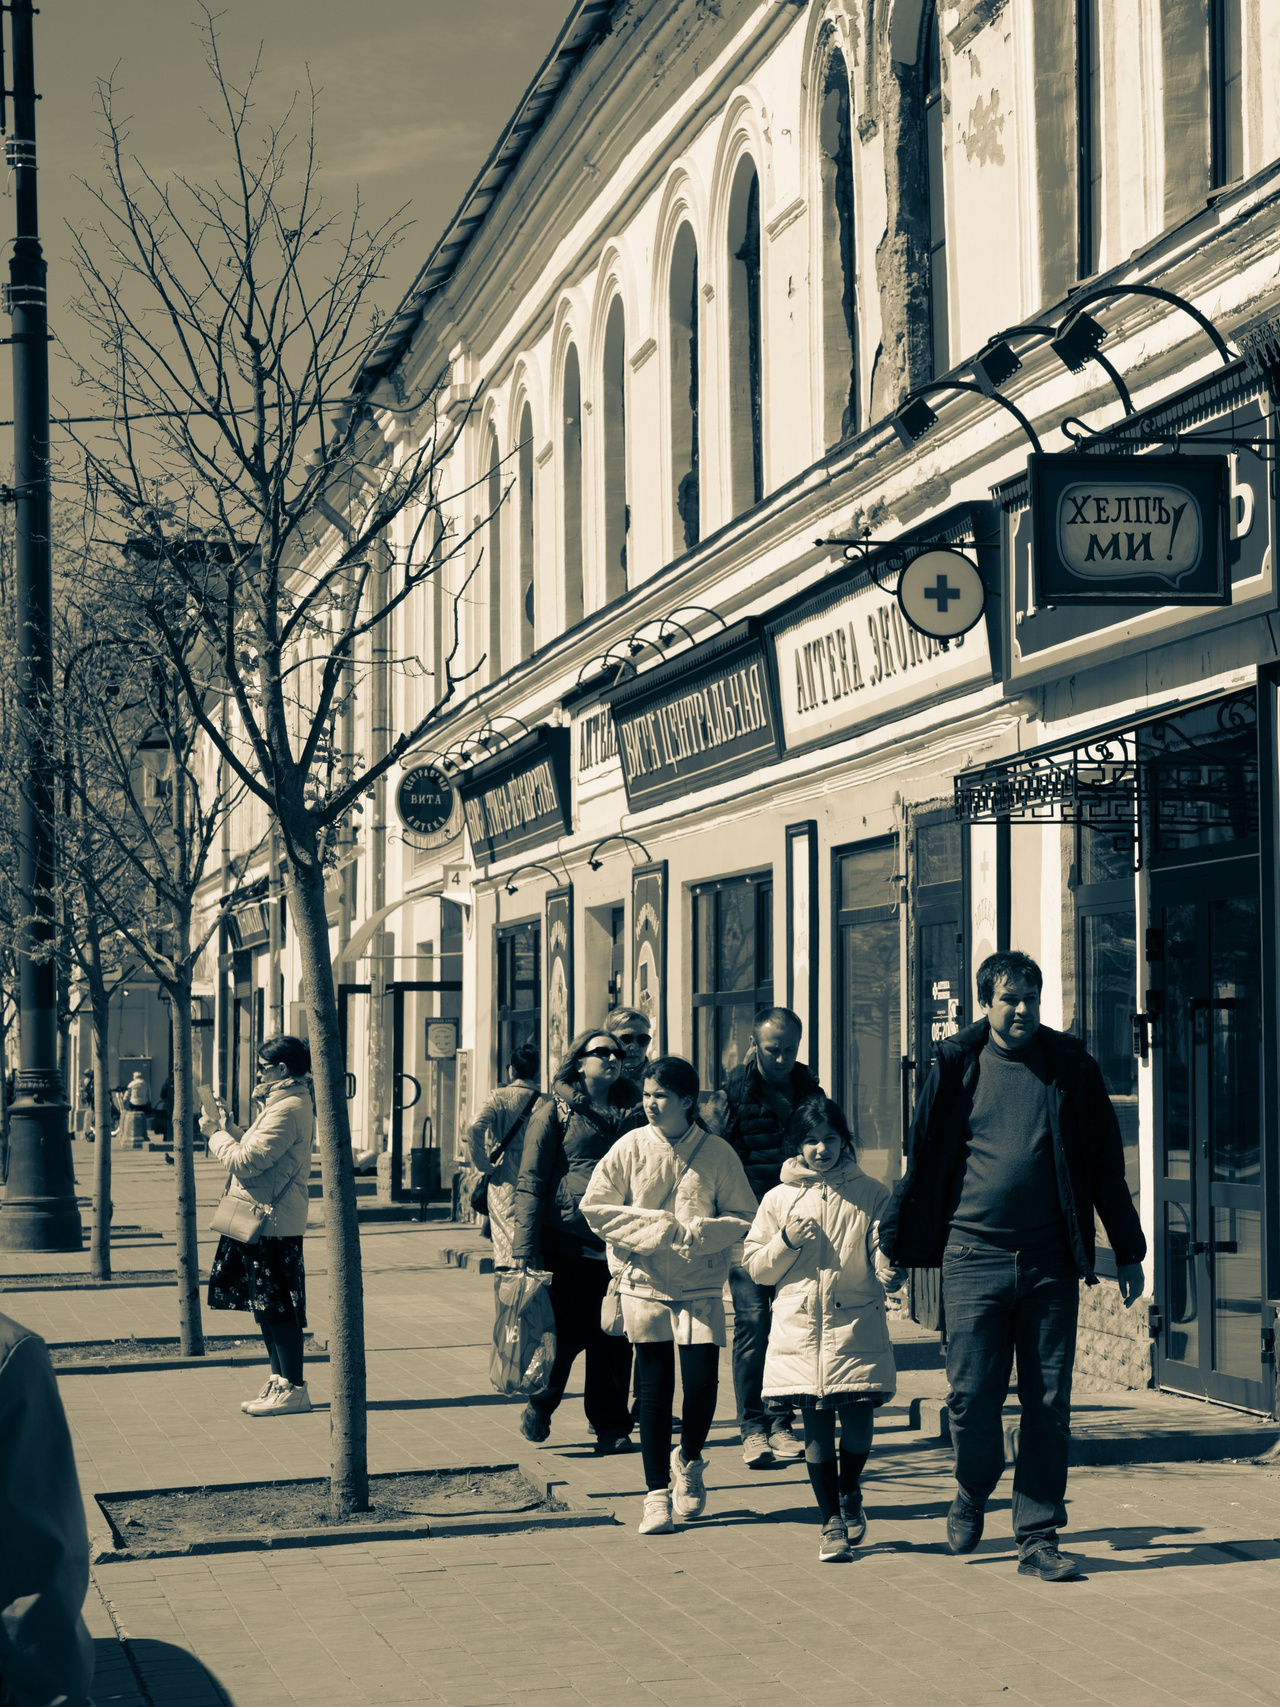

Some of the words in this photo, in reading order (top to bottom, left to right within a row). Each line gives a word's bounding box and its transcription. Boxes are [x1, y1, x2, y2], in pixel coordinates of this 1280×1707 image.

[1066, 494, 1171, 525] ХЕЛПЪ
[794, 621, 865, 715] АПТЕКА
[622, 711, 662, 785] ВИТА
[657, 663, 768, 774] ЦЕНТРАЛЬНАЯ
[410, 794, 442, 805] ВИТА
[406, 815, 446, 832] АПТЕКА
[451, 872, 461, 886] 4
